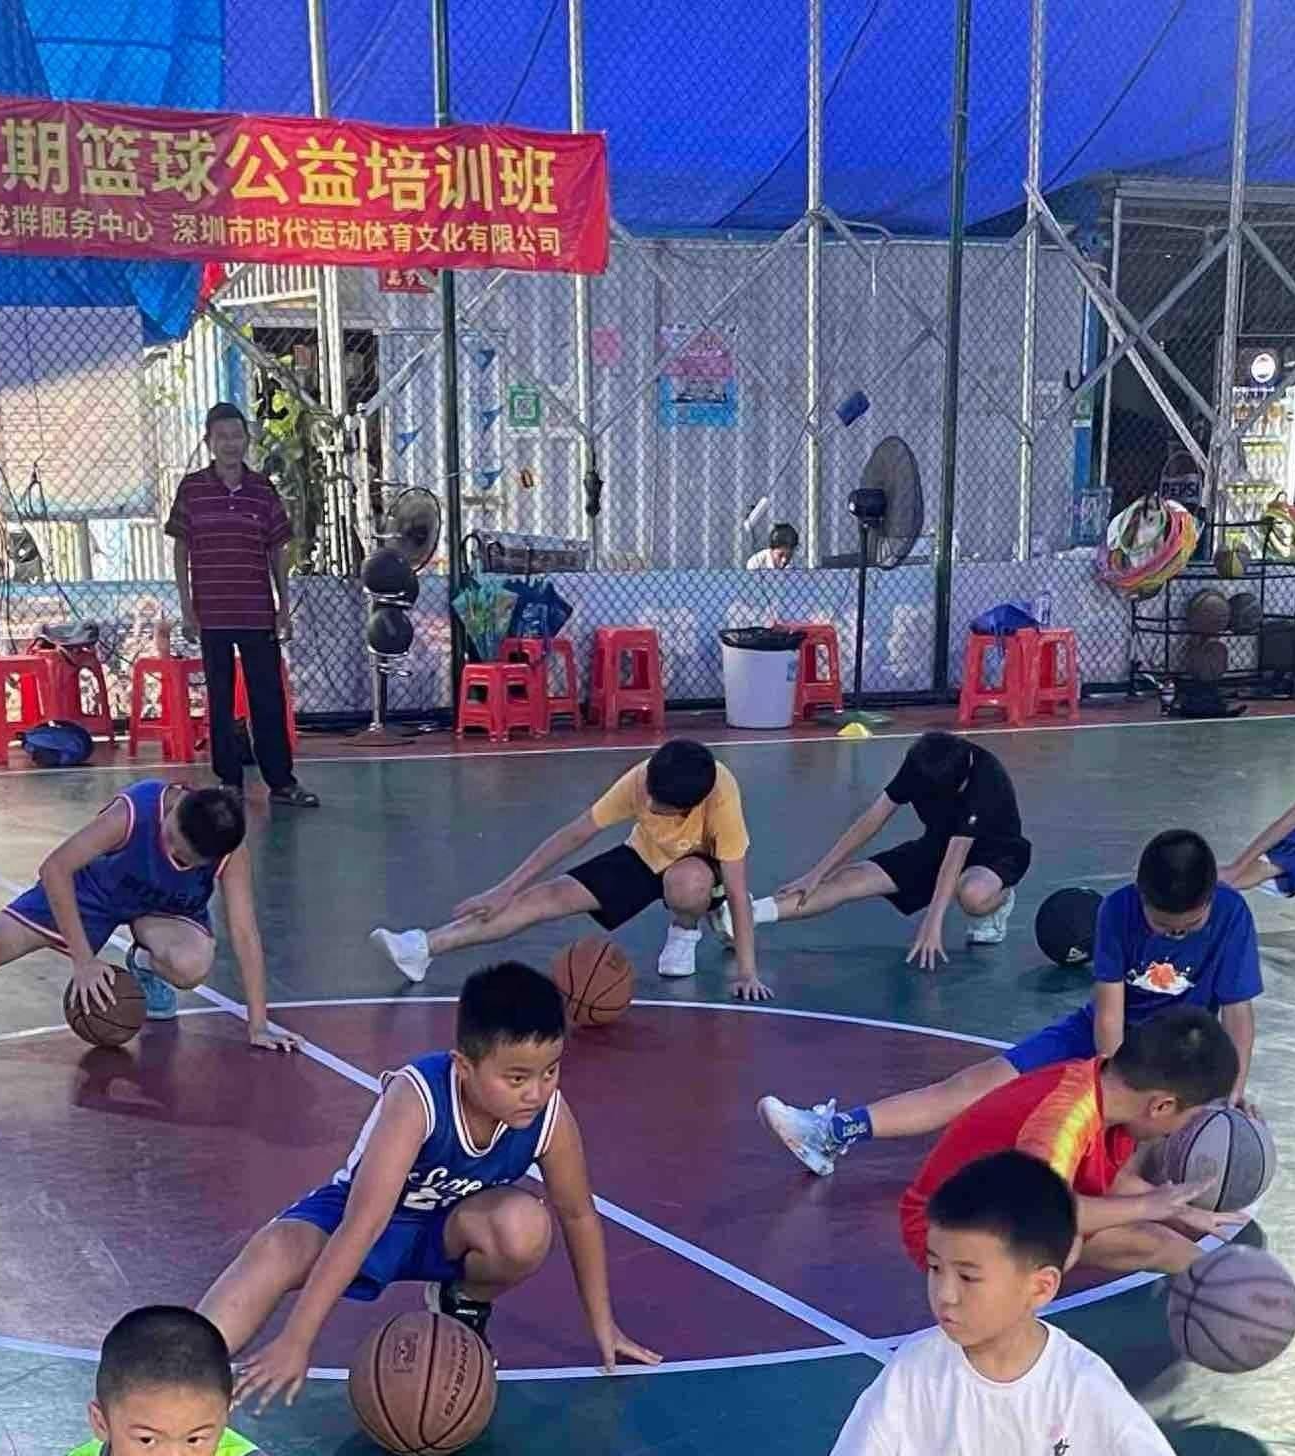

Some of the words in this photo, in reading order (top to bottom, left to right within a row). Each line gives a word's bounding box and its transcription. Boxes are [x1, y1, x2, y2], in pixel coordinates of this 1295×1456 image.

[171, 212, 562, 257] 深圳市时代运动体育文化有限公司
[1162, 481, 1200, 497] PEPSI
